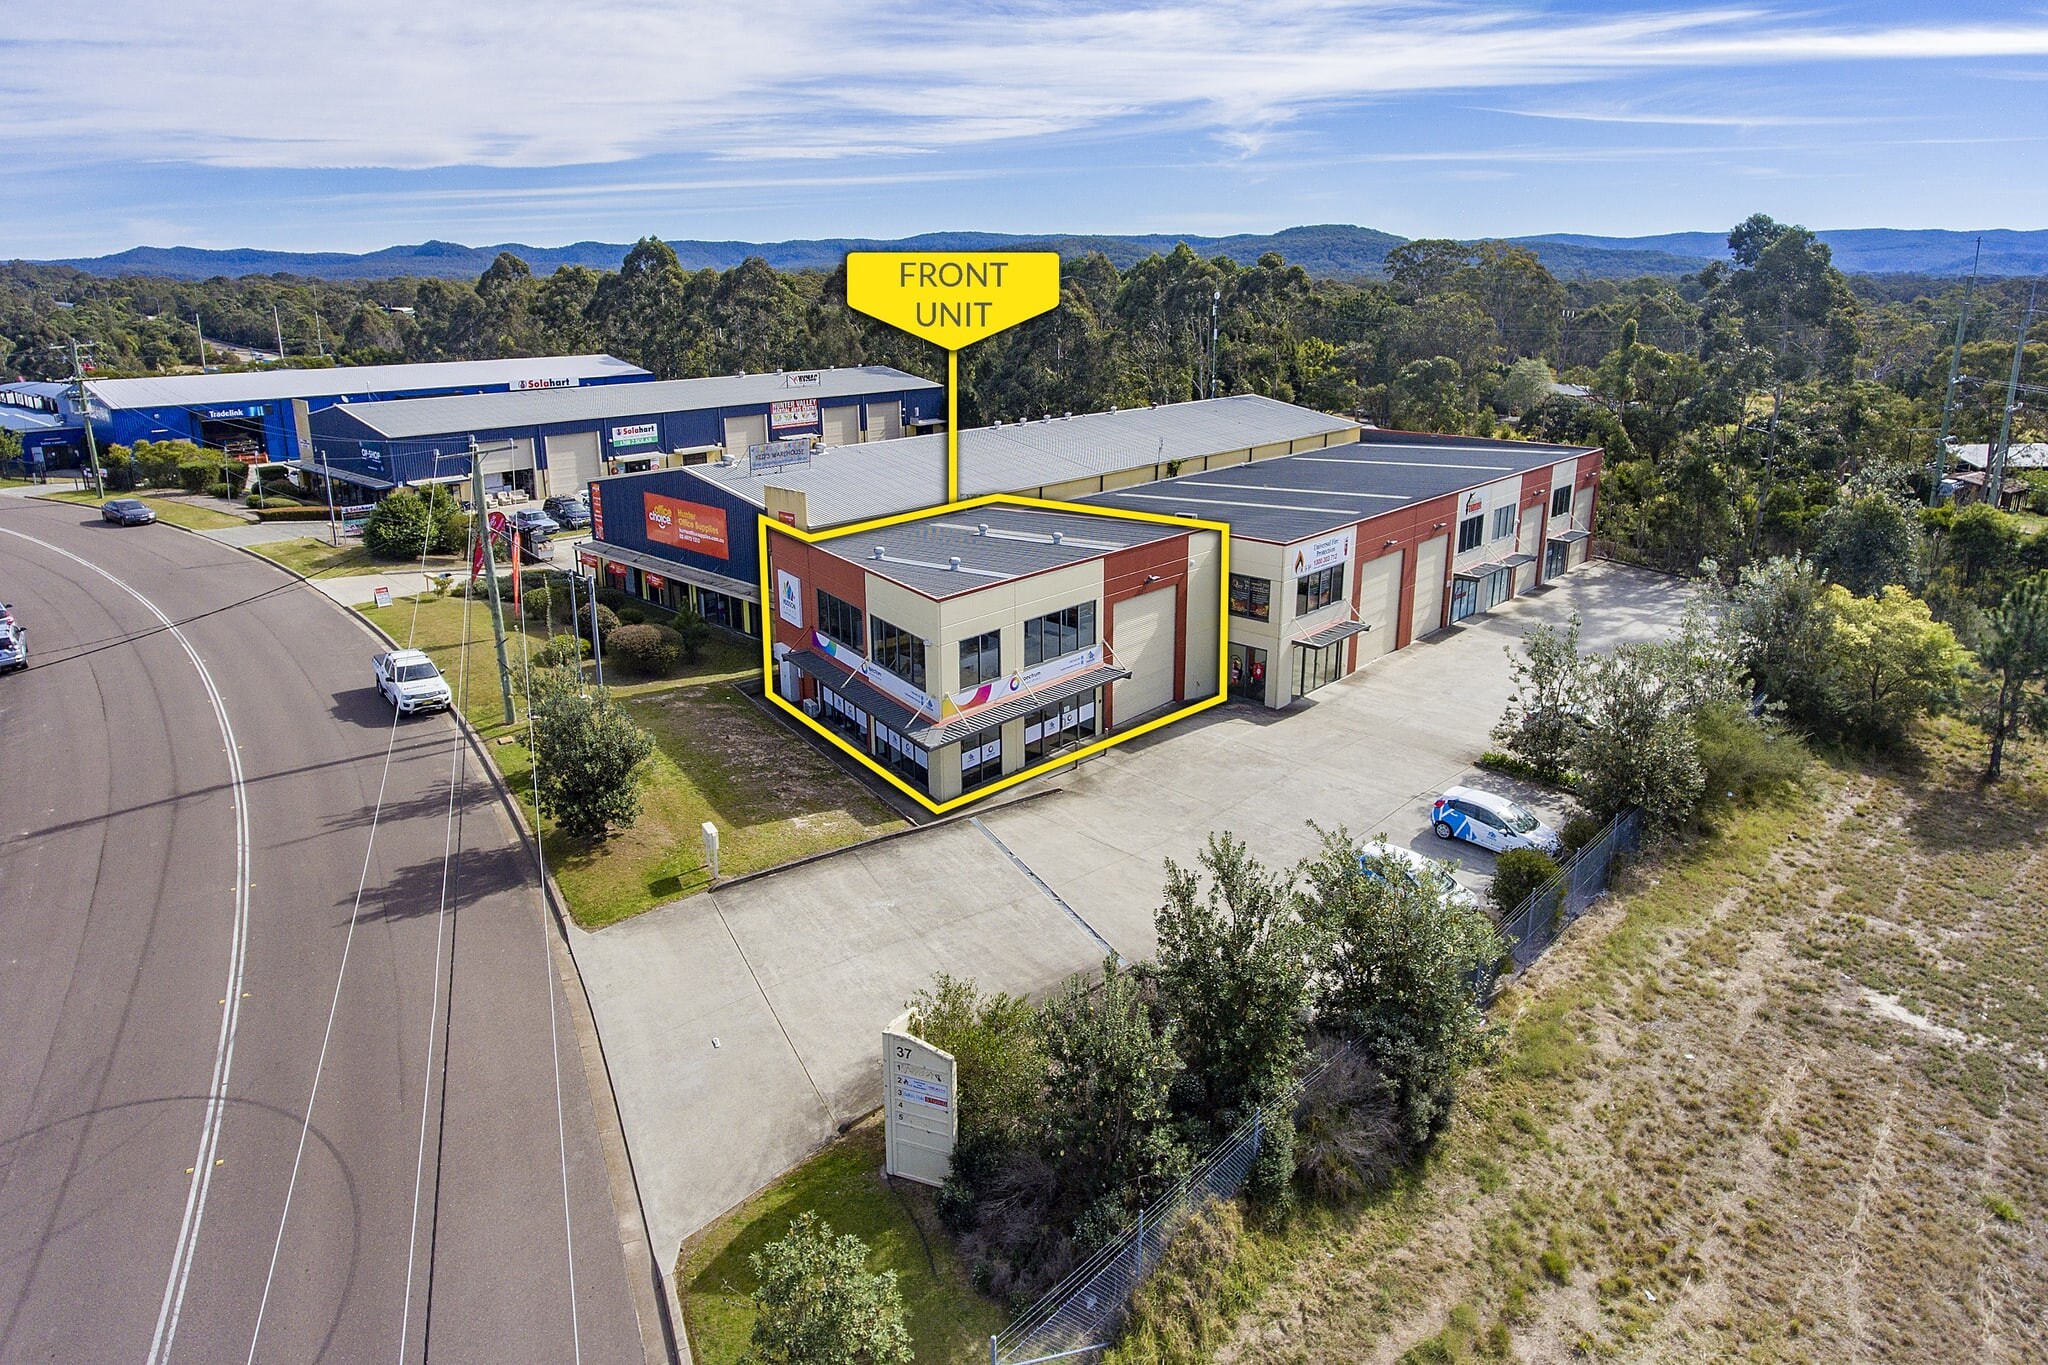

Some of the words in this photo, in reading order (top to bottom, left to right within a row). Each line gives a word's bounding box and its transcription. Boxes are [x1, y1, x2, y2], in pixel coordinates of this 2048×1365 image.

[528, 378, 570, 388] Solahart
[772, 401, 795, 410] HUNTER
[796, 399, 817, 407] VALLEY
[209, 409, 243, 418] Tradelink
[623, 426, 654, 435] Solahart
[772, 448, 804, 458] WAREHOUSE
[654, 504, 672, 516] office
[677, 508, 696, 519] Hunter
[649, 511, 671, 525] choice
[678, 518, 695, 529] Office
[695, 521, 719, 534] Supplies
[1313, 540, 1332, 551] Universal
[1316, 547, 1336, 556] Protection
[897, 1046, 912, 1059] 37
[897, 1076, 902, 1084] 2
